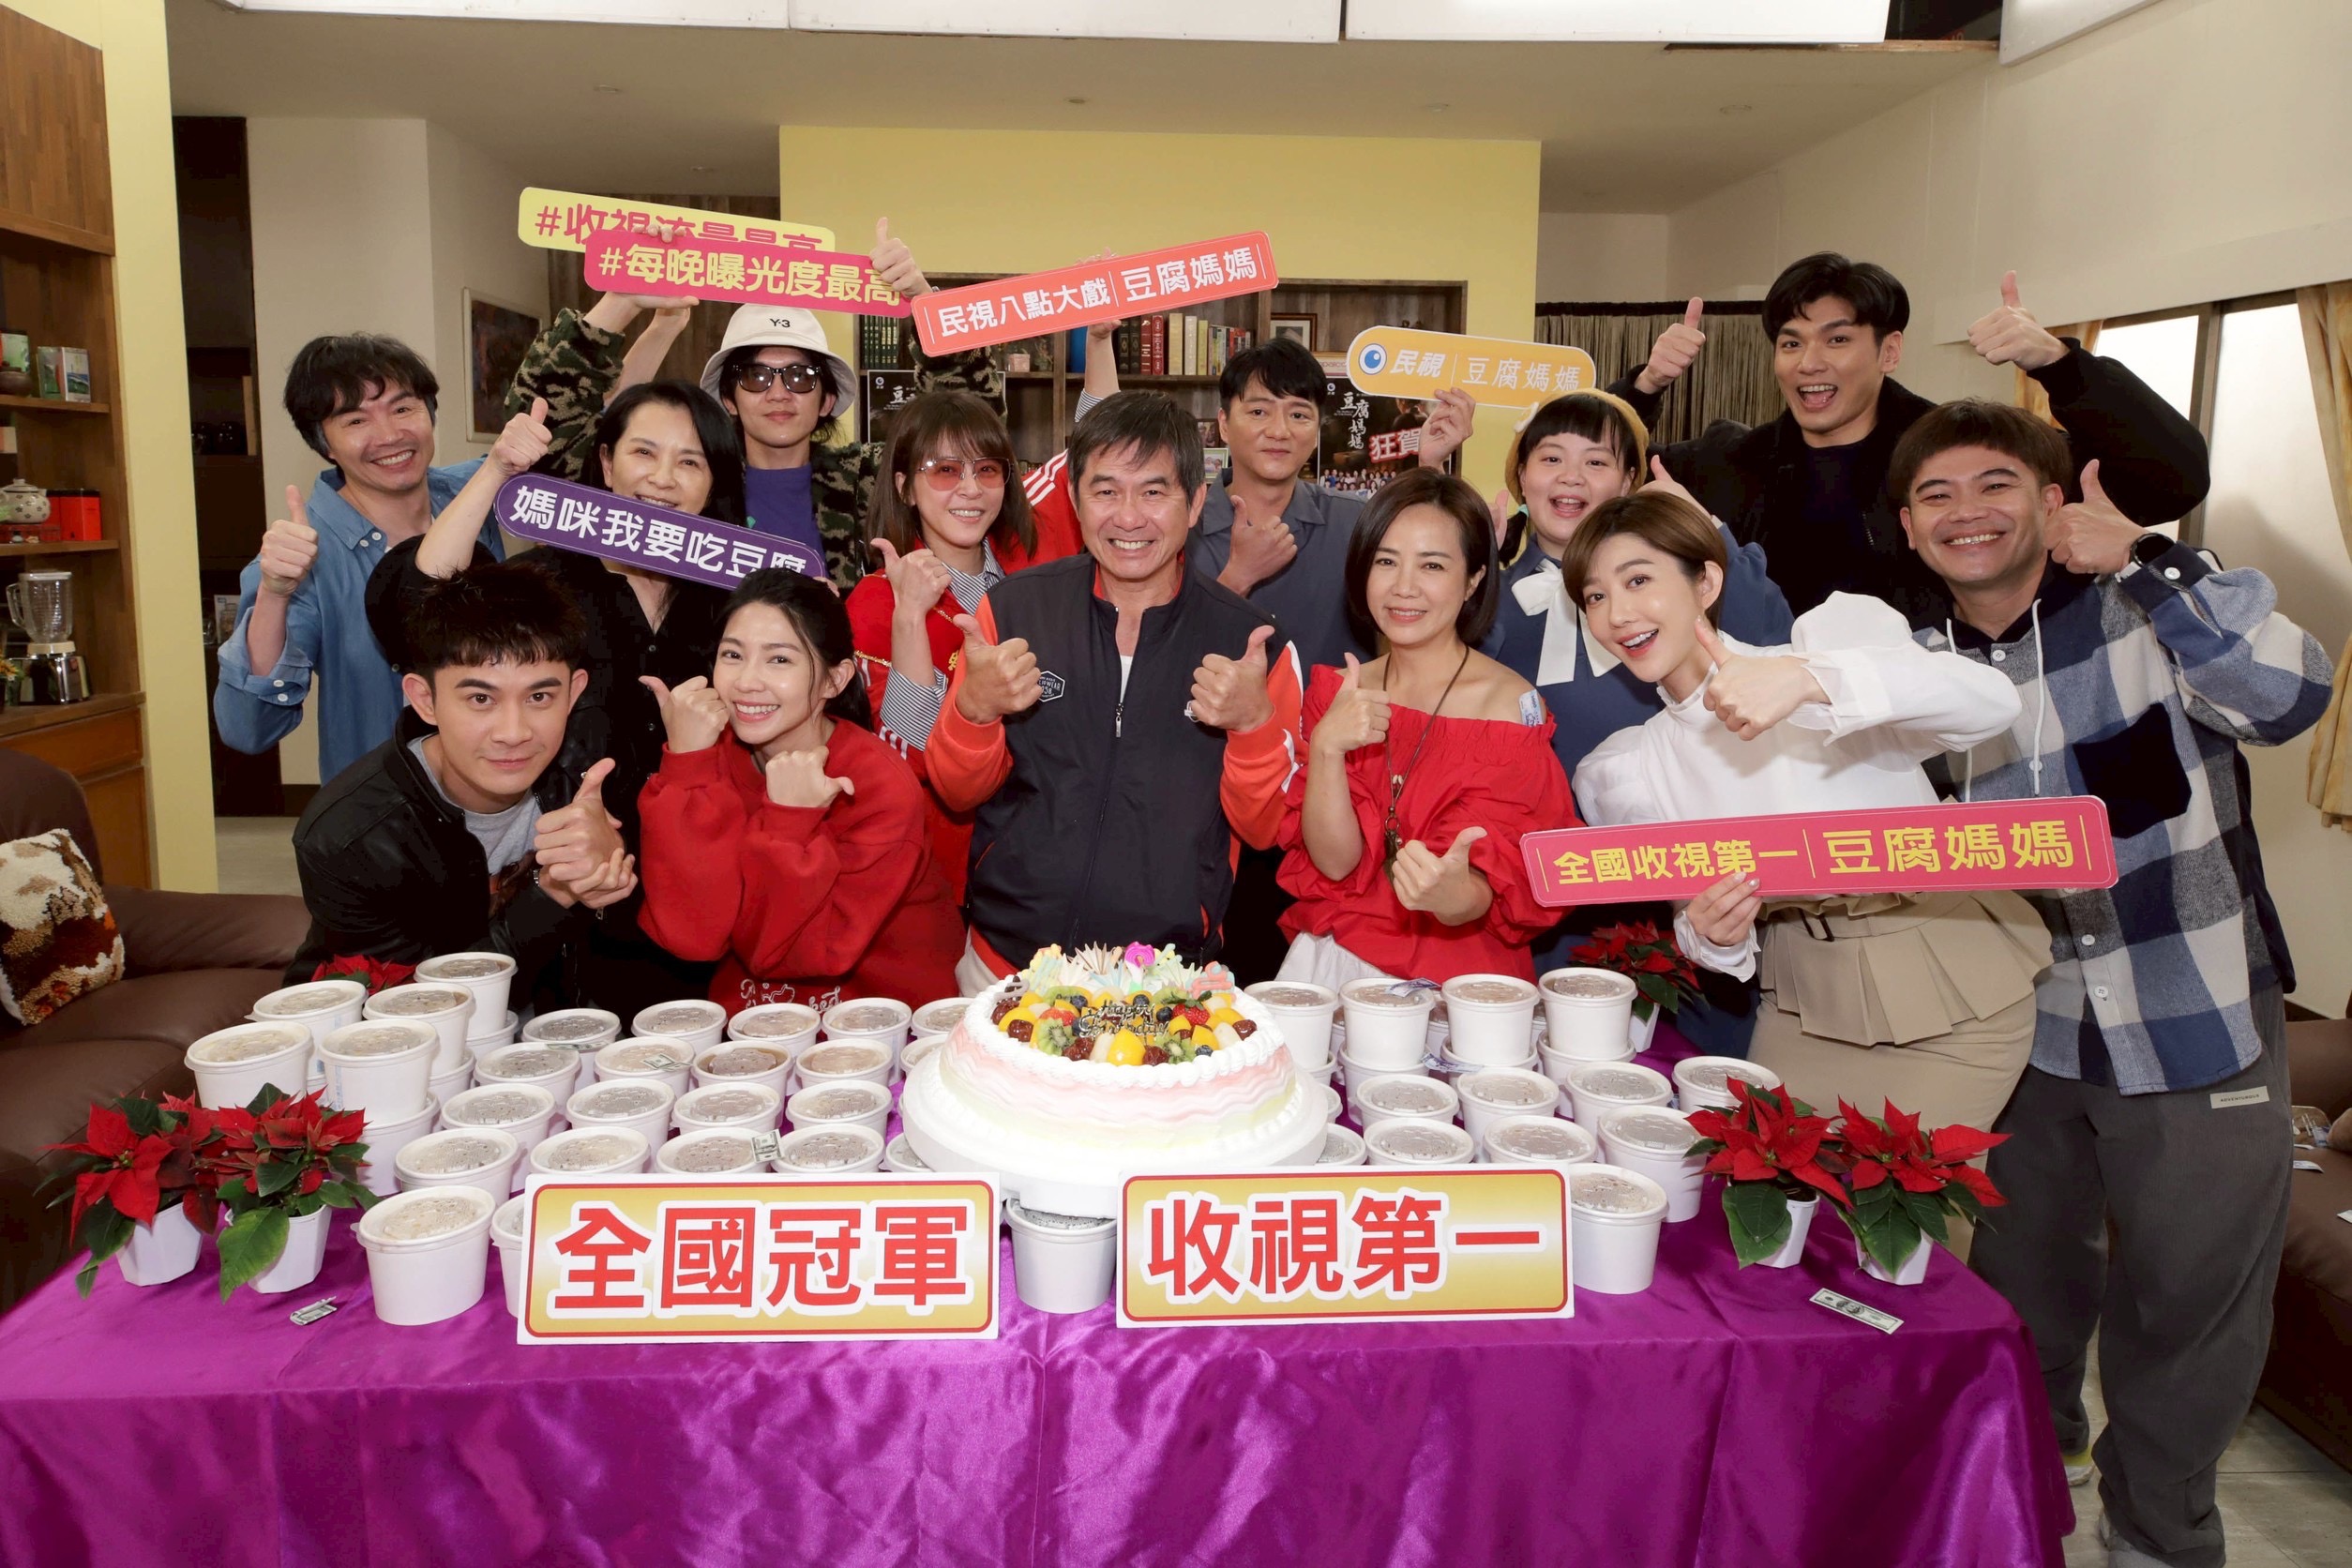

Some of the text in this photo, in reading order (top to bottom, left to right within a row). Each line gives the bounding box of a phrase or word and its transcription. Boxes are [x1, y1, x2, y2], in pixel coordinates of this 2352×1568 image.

[598, 243, 900, 306] #每晚曝光度最高
[938, 247, 1258, 338] 民視八點大戲 豆腐媽媽
[770, 318, 791, 328] Y-3
[1390, 349, 1581, 392] 民視 豆腐媽媽
[1371, 429, 1422, 460] 狂賀
[1553, 820, 2073, 884] 全國收視第一 豆腐媽媽
[555, 1206, 968, 1309] 全國冠軍
[1147, 1196, 1540, 1296] 收視第一
